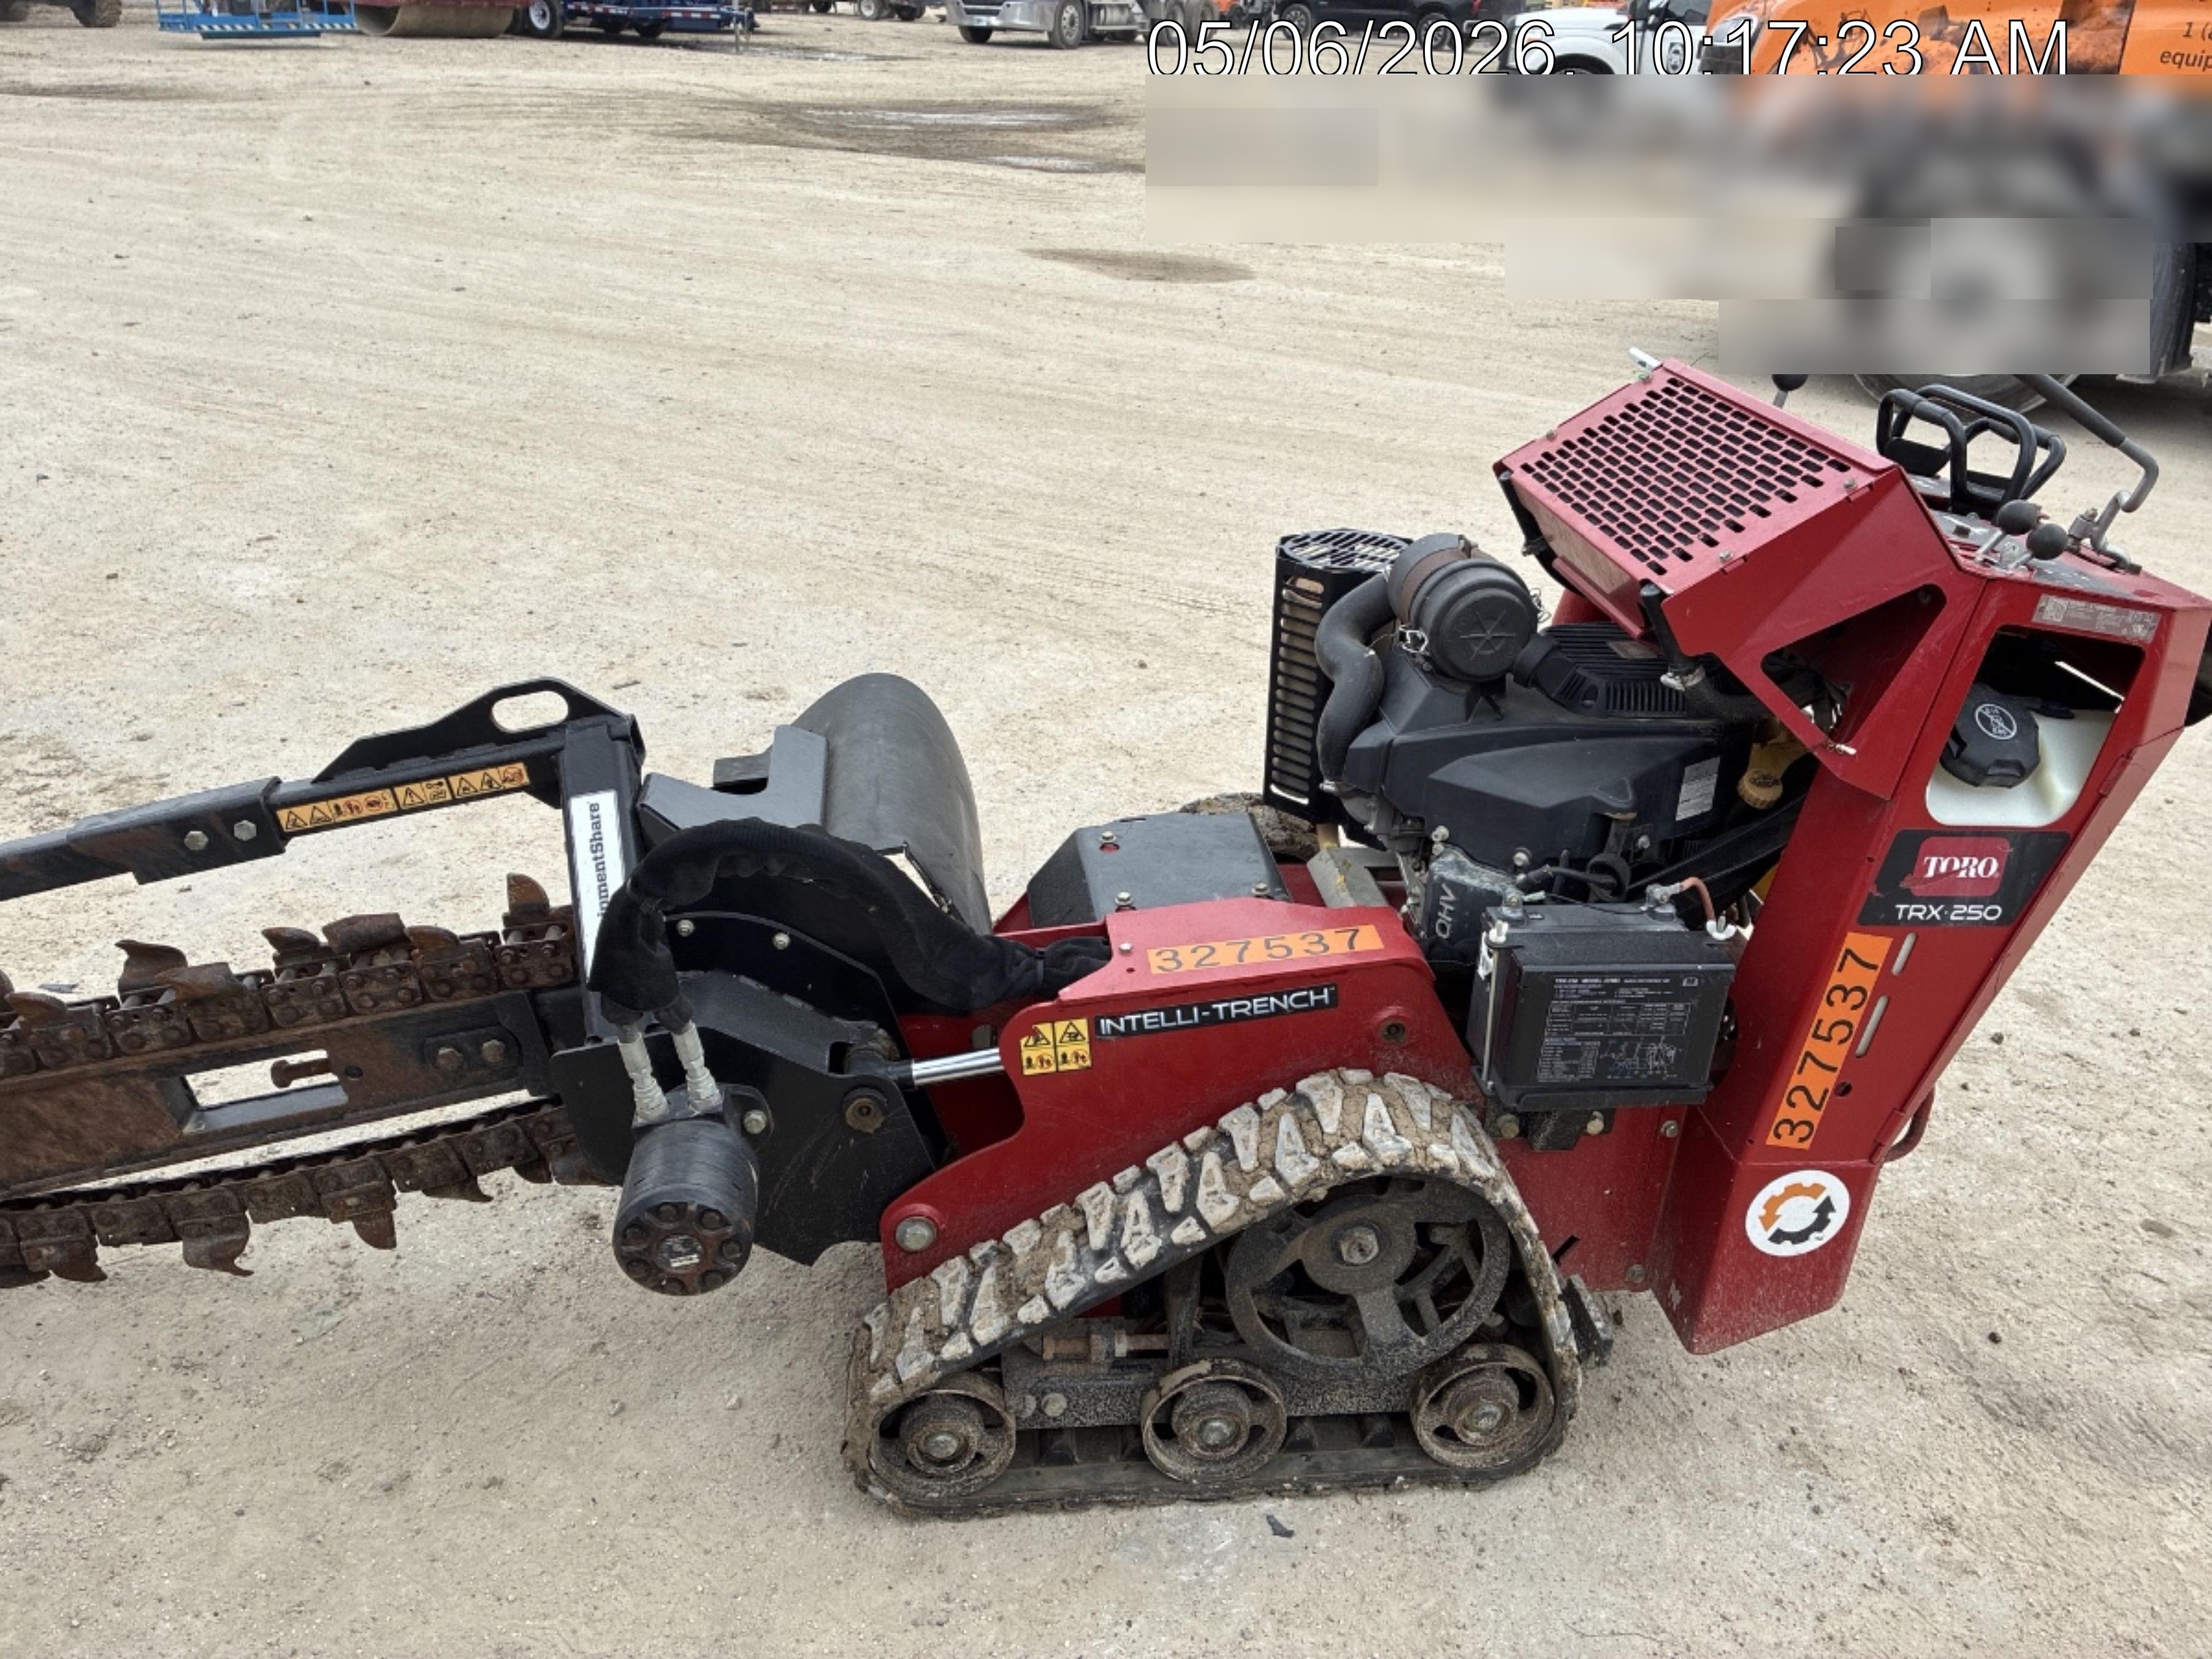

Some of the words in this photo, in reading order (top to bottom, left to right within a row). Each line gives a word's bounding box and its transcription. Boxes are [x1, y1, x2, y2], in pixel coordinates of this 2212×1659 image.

[589, 802, 610, 917] pmentShare
[1924, 856, 1998, 878] TORO
[1435, 882, 1456, 939] OHV
[1155, 928, 1360, 973] 327537
[1099, 987, 1330, 1035] INTELLI-TRENCH
[1772, 947, 1879, 1143] 327537
